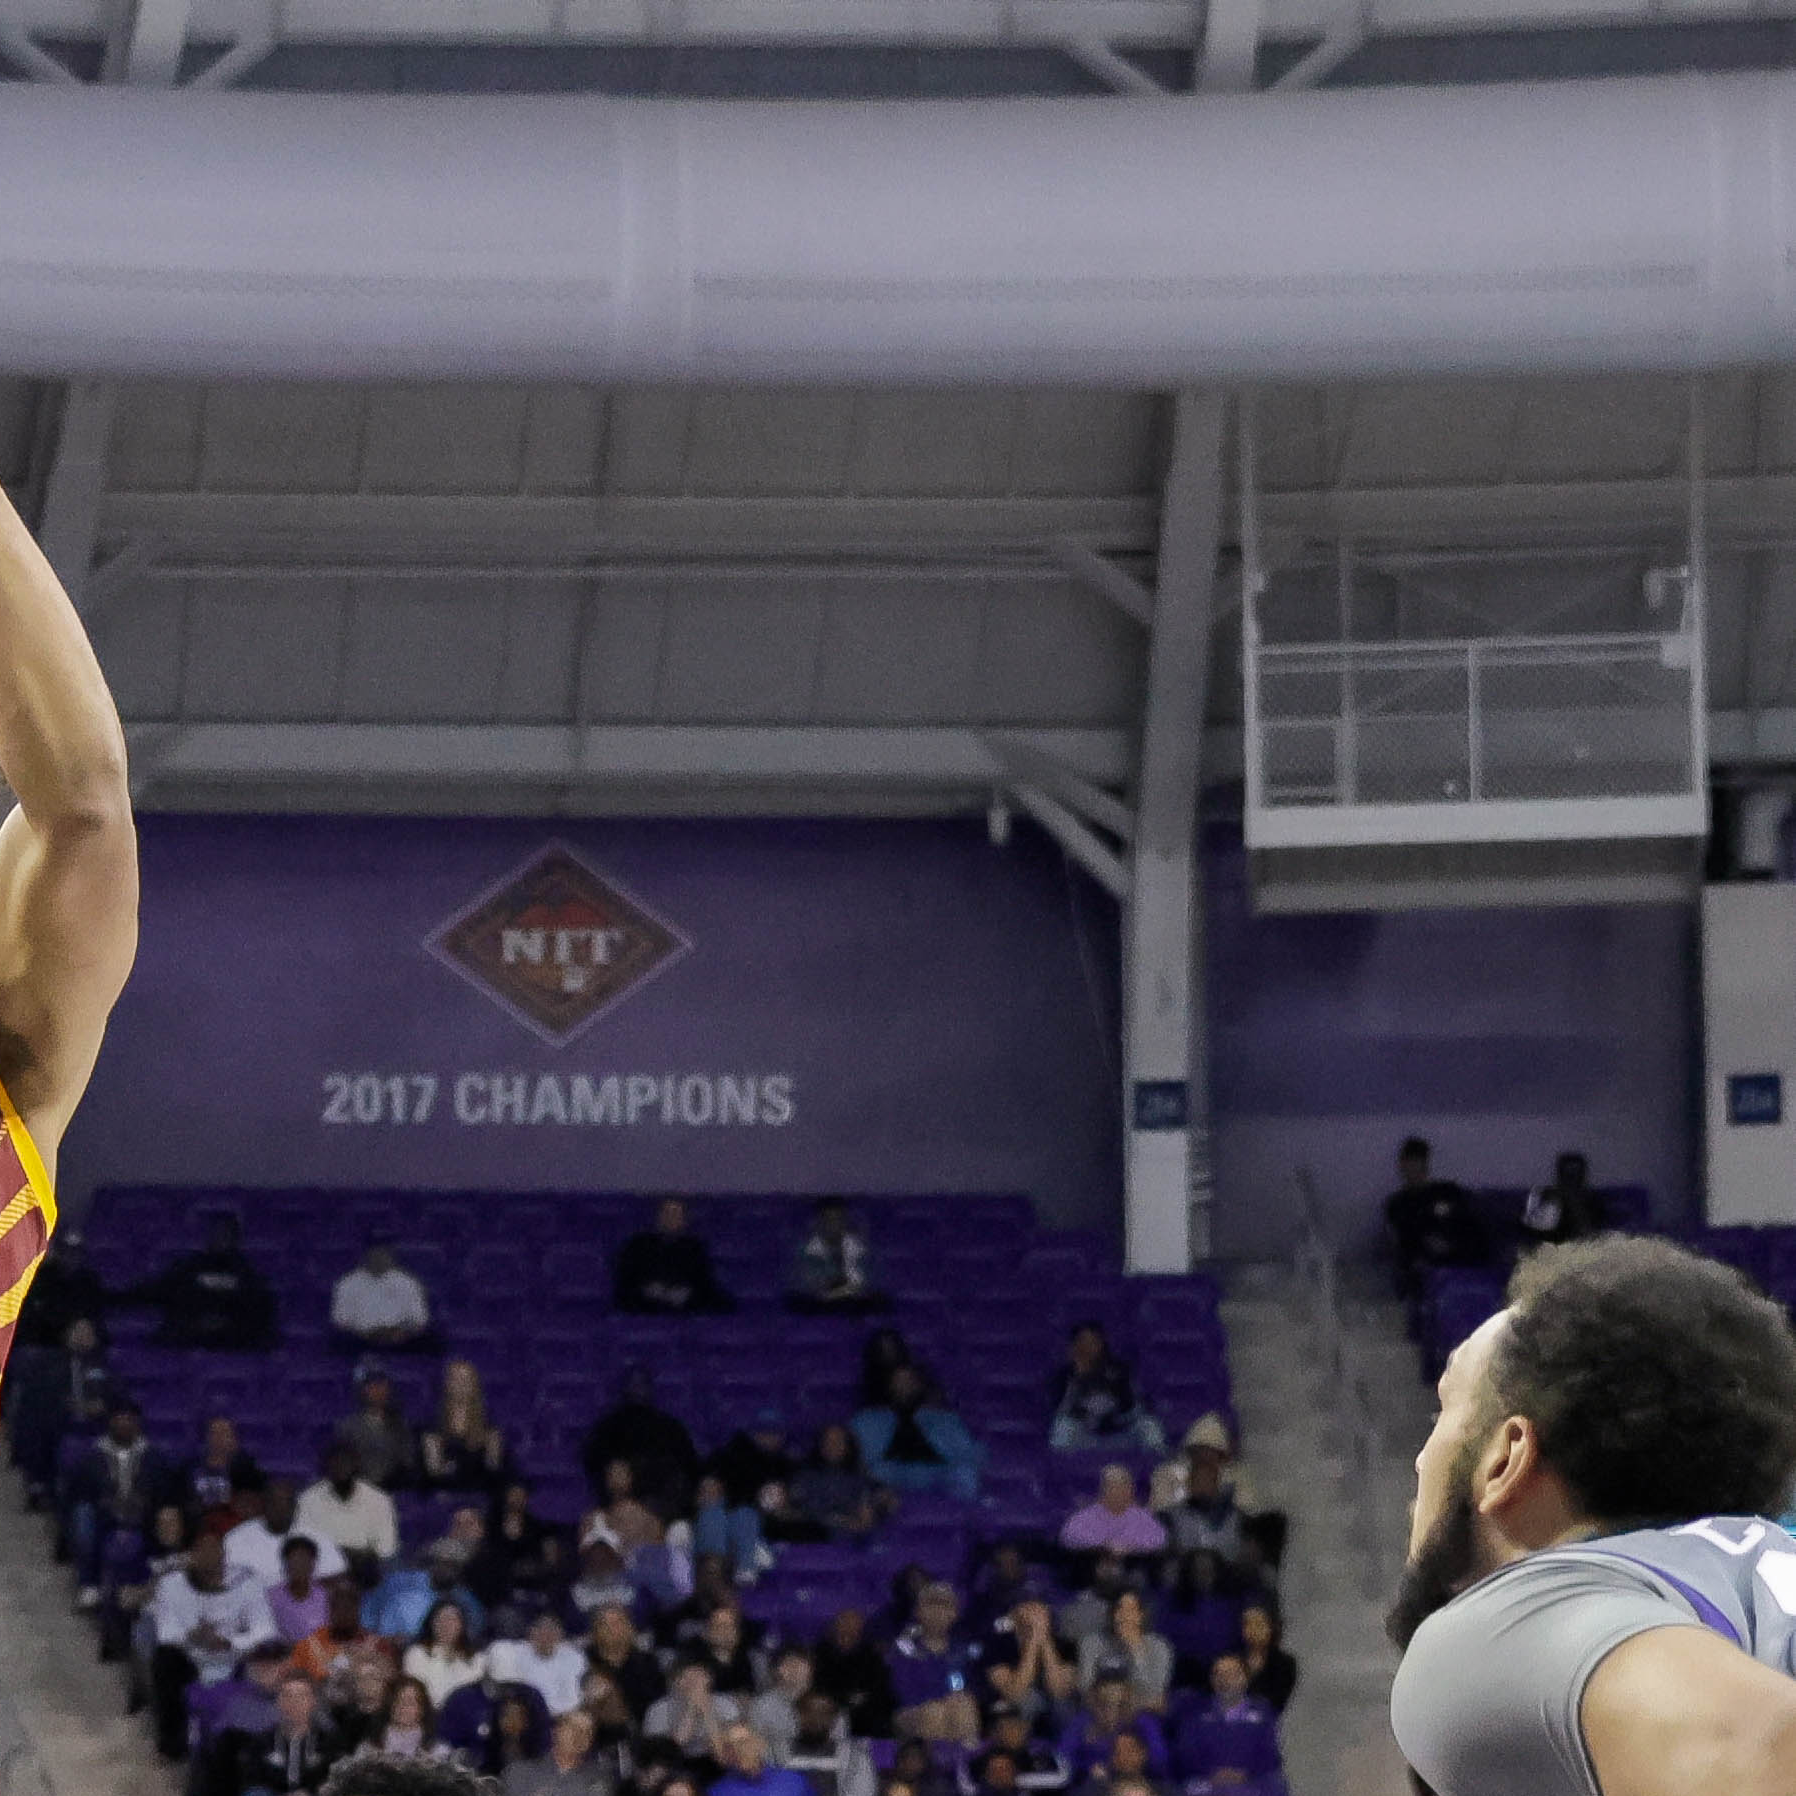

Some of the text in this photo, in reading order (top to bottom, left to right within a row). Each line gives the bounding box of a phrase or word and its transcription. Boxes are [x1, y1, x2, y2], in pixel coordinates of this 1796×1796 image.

[499, 926, 625, 967] NIT
[321, 1071, 796, 1127] 2017 CHAMPIONS
